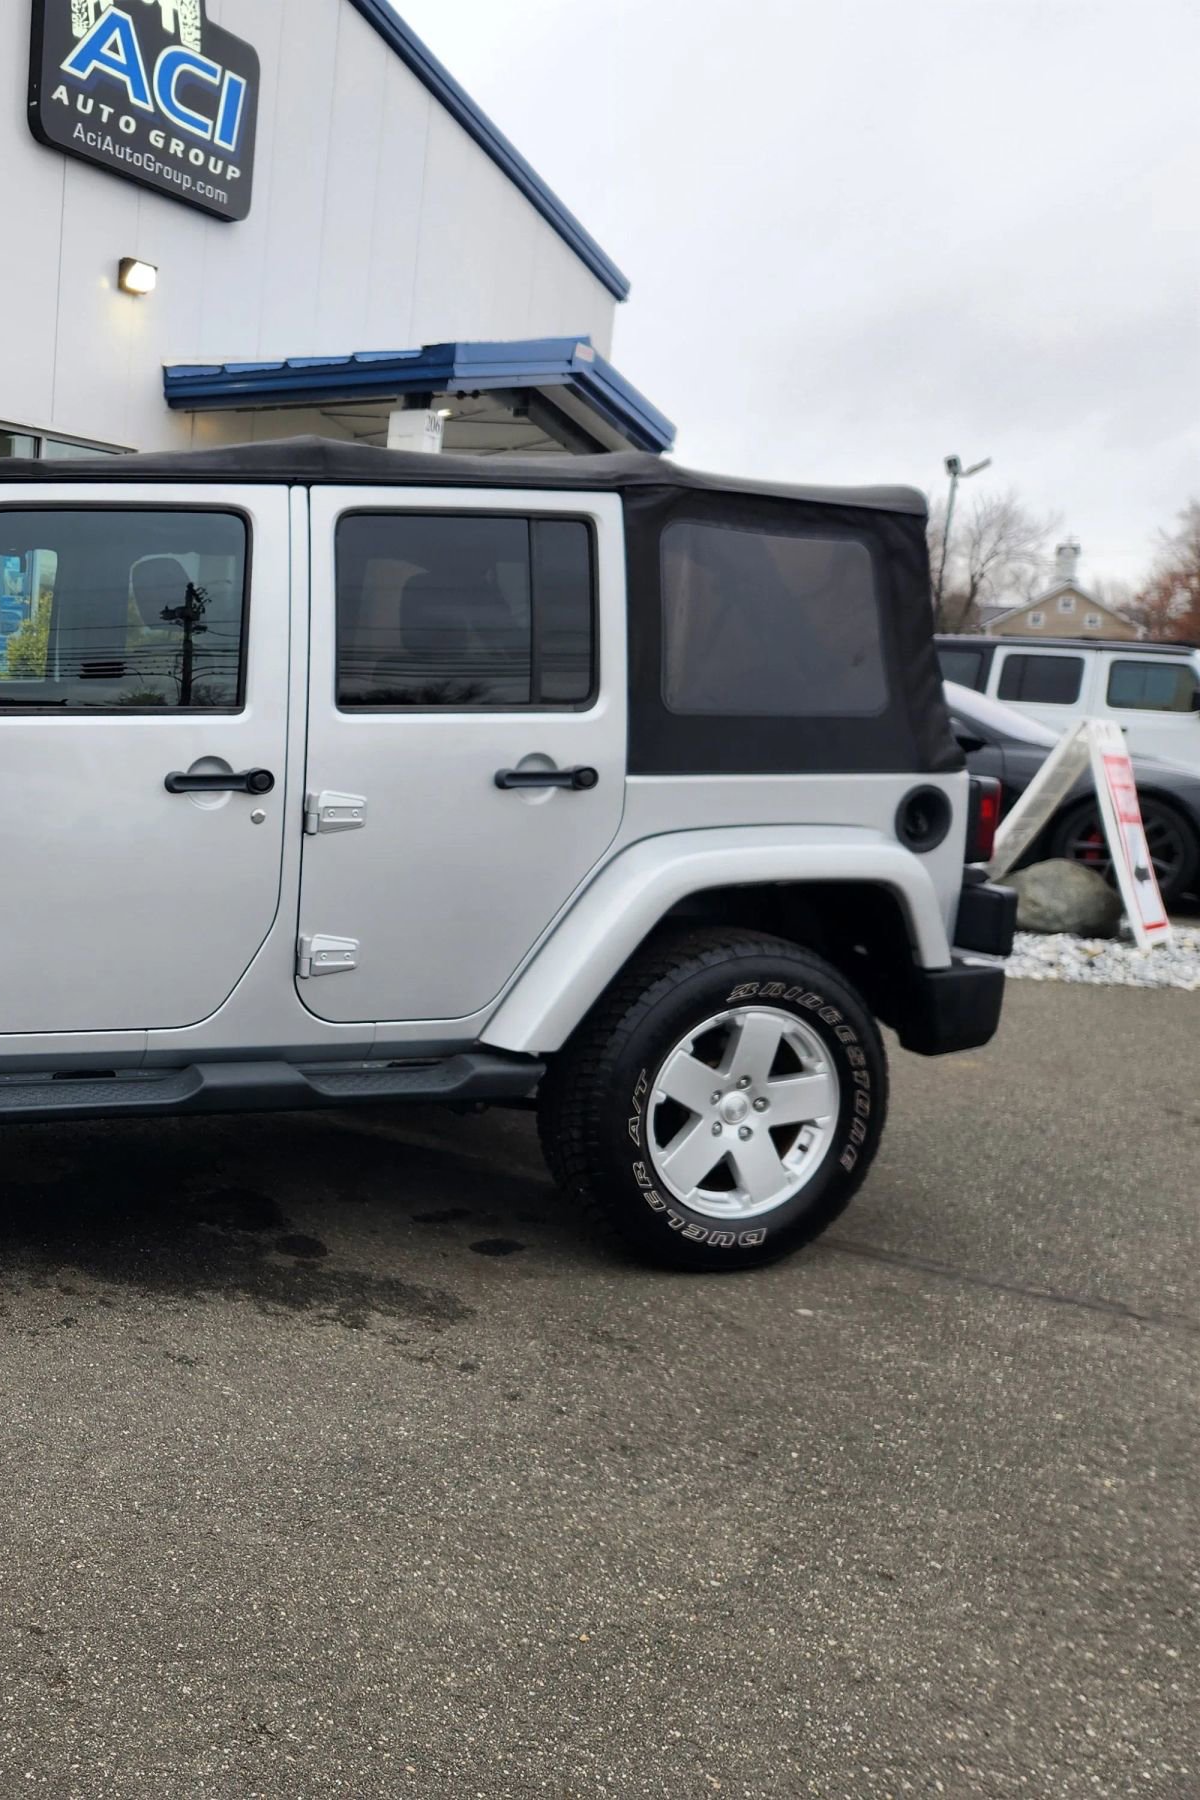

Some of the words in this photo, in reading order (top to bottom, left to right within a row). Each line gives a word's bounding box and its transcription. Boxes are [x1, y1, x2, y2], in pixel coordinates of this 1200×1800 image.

[60, 5, 247, 152] ACI
[51, 85, 137, 135] AUTO
[149, 129, 242, 181] GROUP
[72, 122, 229, 205] AciAutoGroup.com
[628, 1068, 648, 1147] A/T
[726, 981, 871, 1172] BRIDGESTONE
[632, 1160, 768, 1248] DUELER
